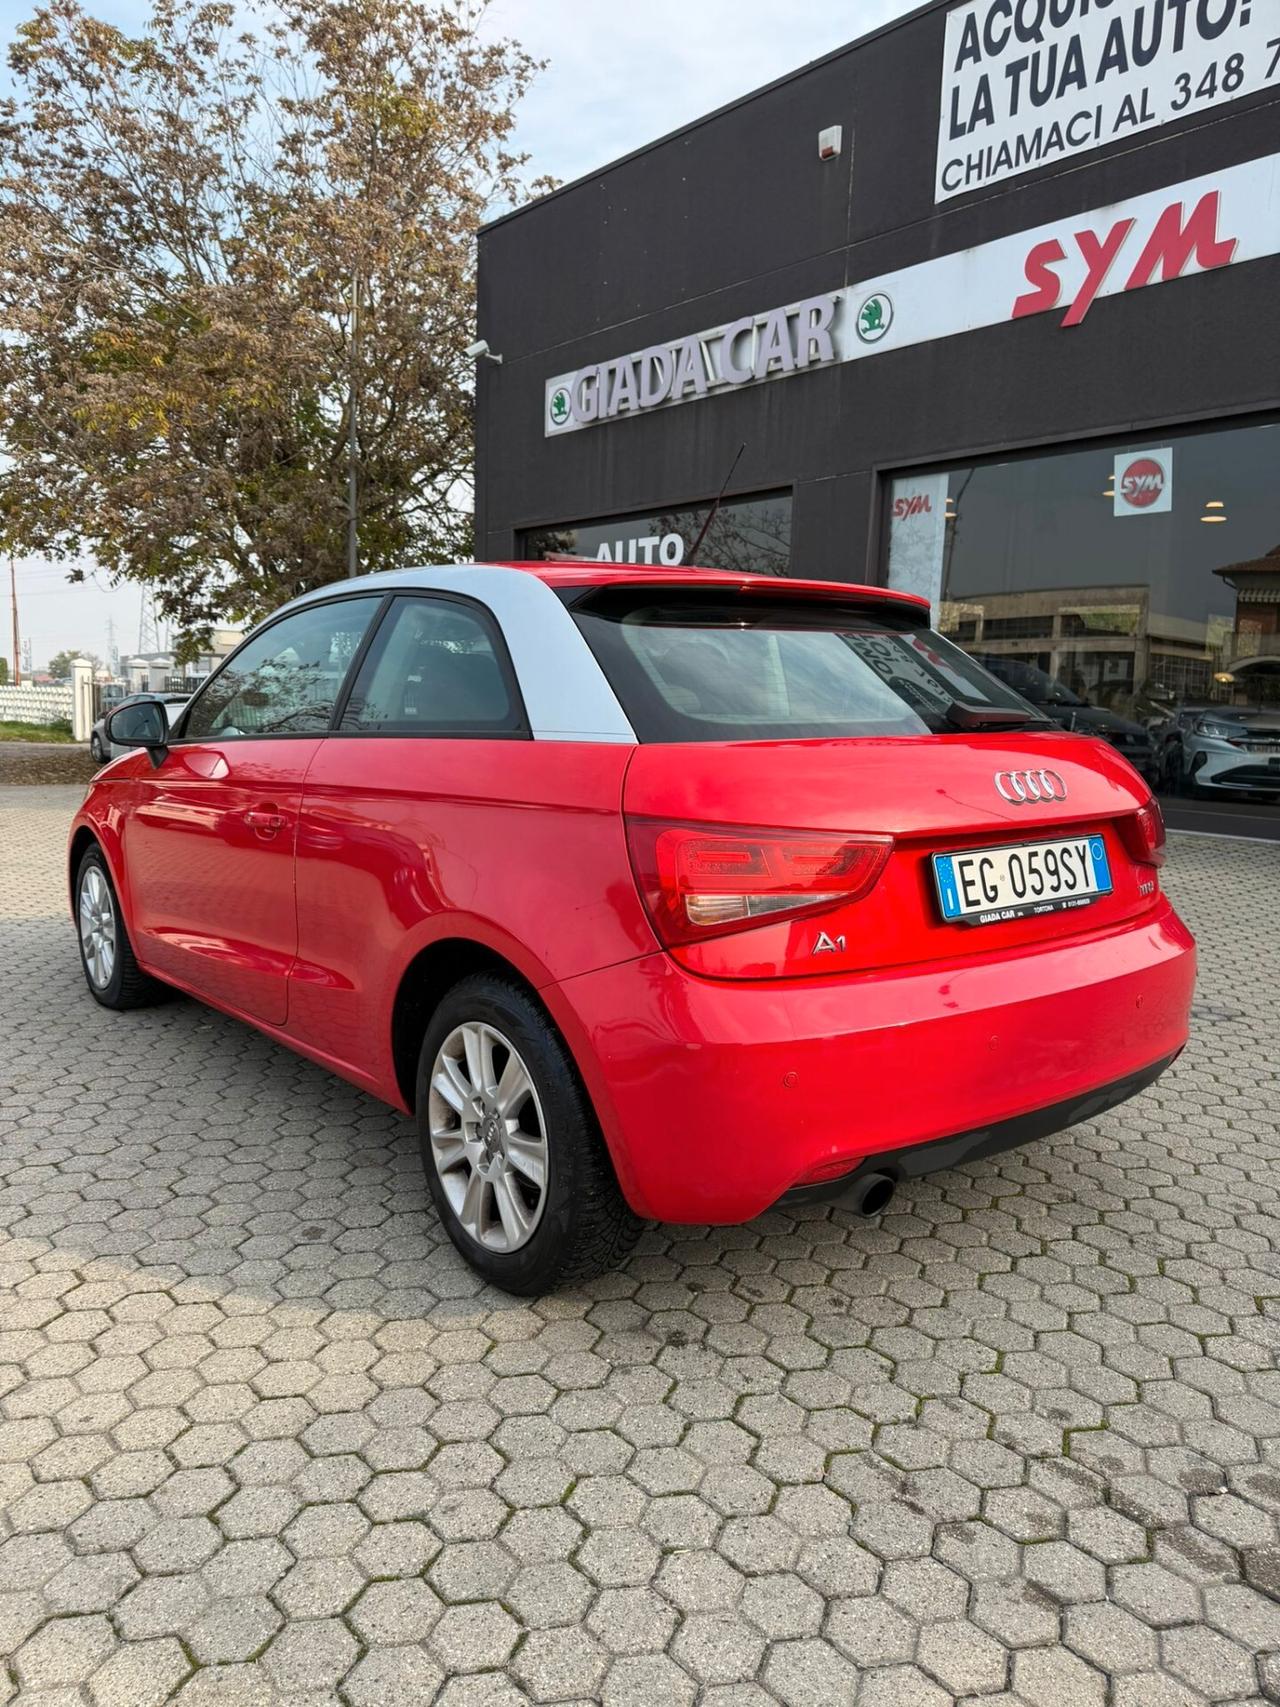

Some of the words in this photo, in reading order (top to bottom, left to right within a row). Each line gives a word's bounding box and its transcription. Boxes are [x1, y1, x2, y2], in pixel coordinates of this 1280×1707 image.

[954, 0, 1114, 72] ACQU
[949, 73, 995, 141] LA
[1005, 34, 1087, 117] TUA
[941, 105, 1103, 191] CHIAMACI
[1113, 87, 1155, 133] AL
[1170, 53, 1244, 111] 348
[1011, 190, 1239, 328] SYM
[571, 336, 709, 424] GIADA
[718, 294, 837, 385] CAR
[893, 494, 932, 521] SYM
[1121, 472, 1164, 497] SYM
[596, 533, 684, 567] AUTO
[958, 857, 999, 908] EG
[1008, 844, 1091, 899] 059SY
[812, 931, 847, 955] A1
[980, 912, 1001, 923] GIADA
[1001, 910, 1016, 919] CAR
